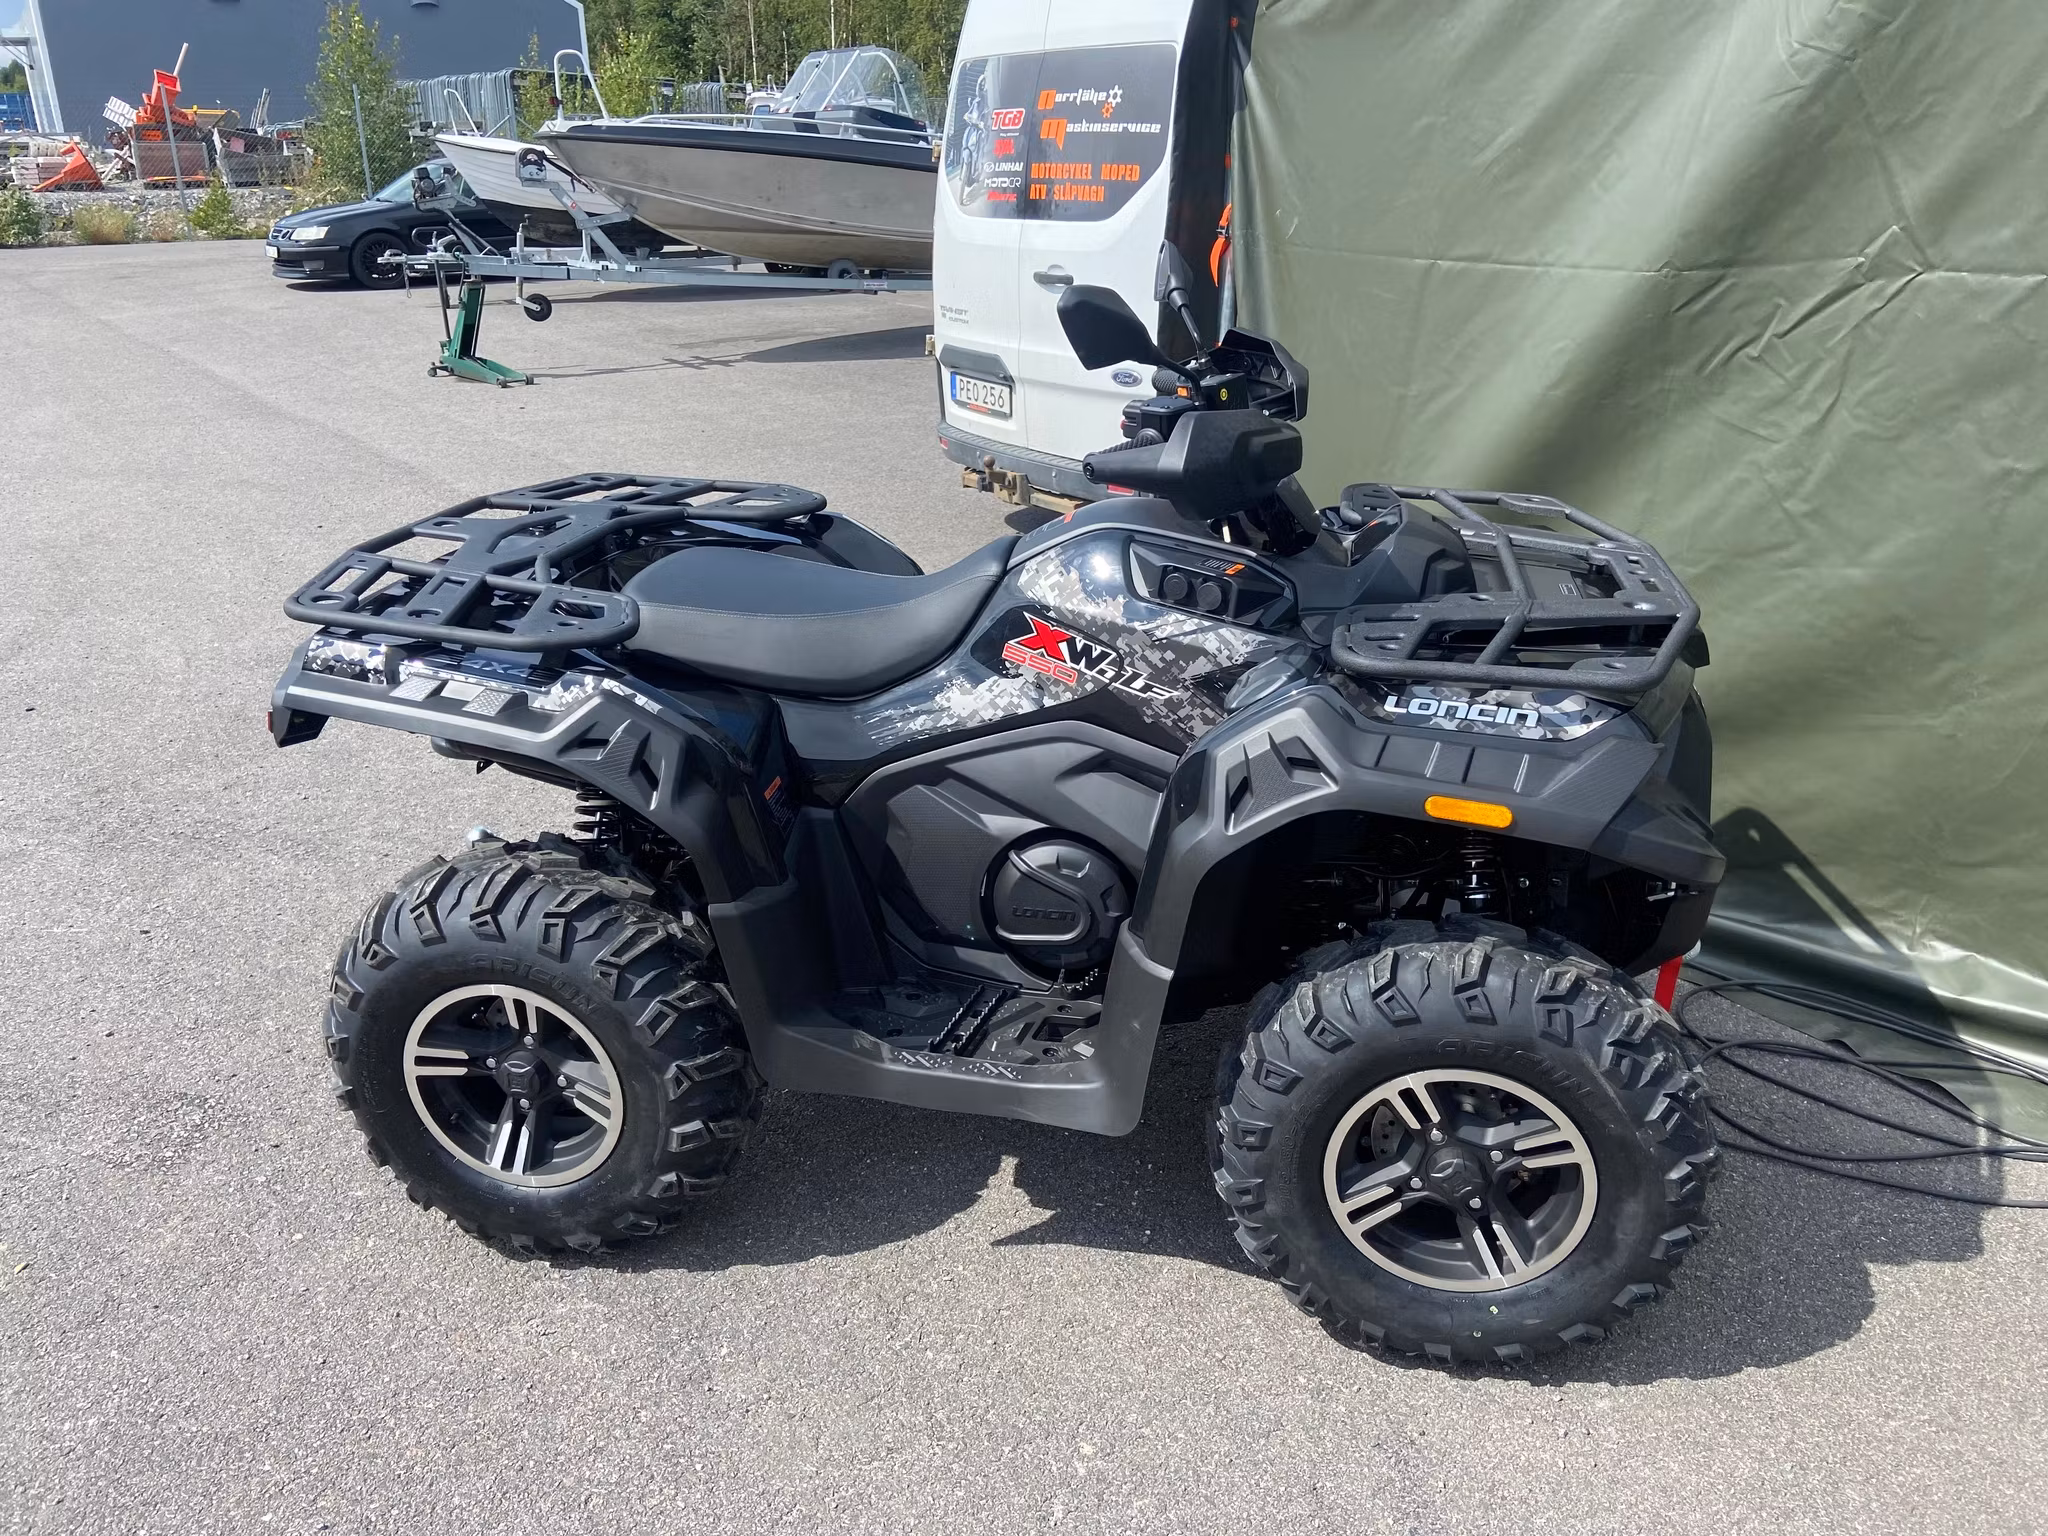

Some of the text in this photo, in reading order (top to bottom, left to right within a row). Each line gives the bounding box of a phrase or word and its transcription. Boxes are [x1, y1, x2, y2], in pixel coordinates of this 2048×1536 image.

[992, 109, 1024, 129] TGB
[995, 162, 1023, 172] LINHAI
[1031, 163, 1140, 182] MOTORCYKEL MOPED
[1030, 184, 1047, 200] ATV
[959, 378, 979, 403] PEO
[982, 385, 1005, 409] 256
[1002, 643, 1079, 686] 550
[1383, 695, 1540, 727] LONCIN
[1011, 905, 1077, 922] LONCIN
